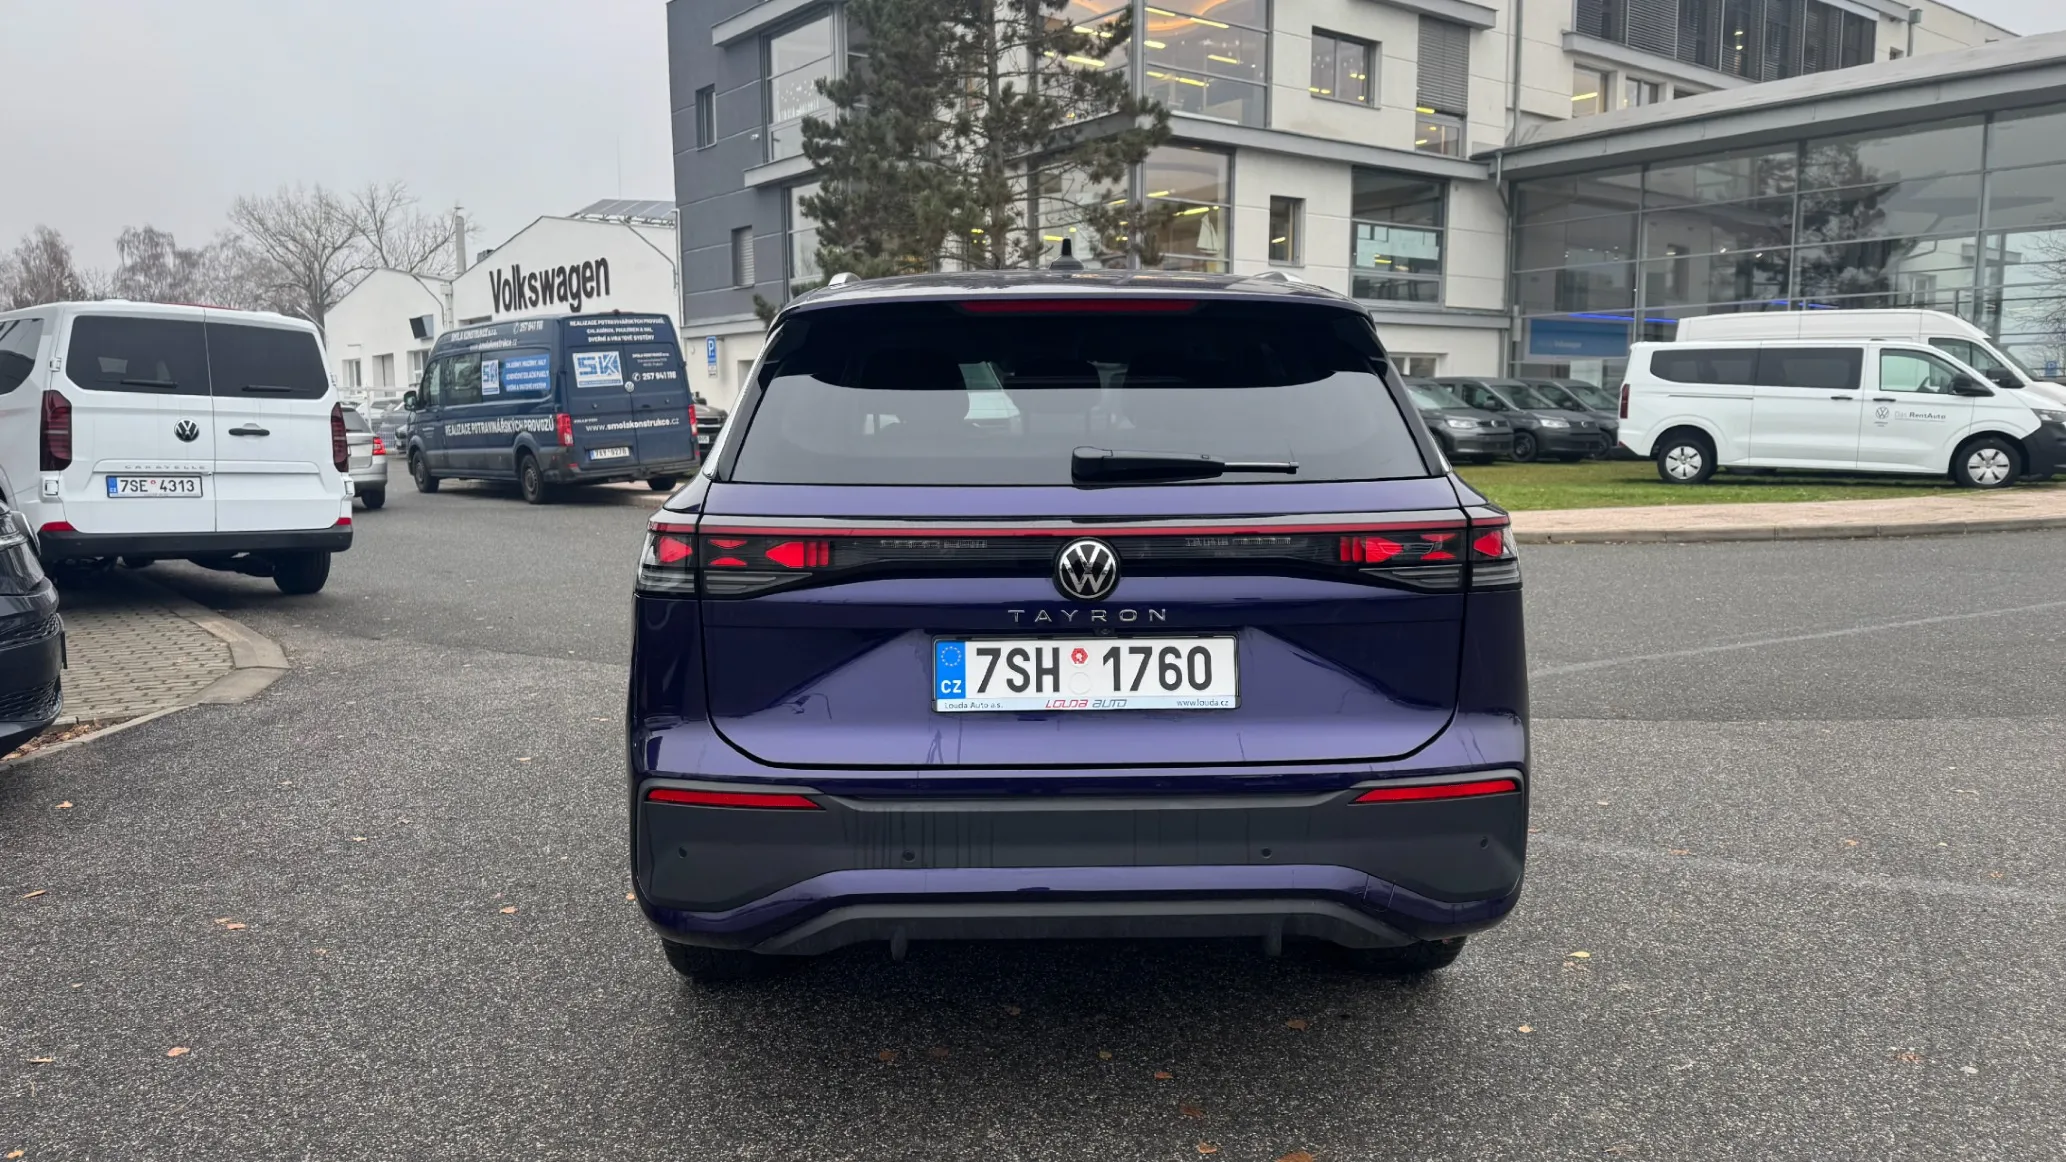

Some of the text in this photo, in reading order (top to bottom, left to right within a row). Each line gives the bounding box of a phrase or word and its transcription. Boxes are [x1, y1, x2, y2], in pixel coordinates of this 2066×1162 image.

[489, 256, 611, 314] Volkswagen
[577, 353, 620, 376] SK
[642, 372, 654, 381] 257
[1909, 412, 1946, 420] RentAuto
[445, 422, 472, 436] REALIZACE
[472, 416, 524, 434] POTRAVINÁŘSKÝCH
[524, 414, 555, 433] PROVOZŮ
[120, 480, 148, 492] 7SE
[160, 480, 195, 492] 4313
[1008, 608, 1167, 623] TAYRON
[941, 646, 1212, 694] CZ 7SH 1760
[1176, 698, 1229, 708] www.louda.cz
